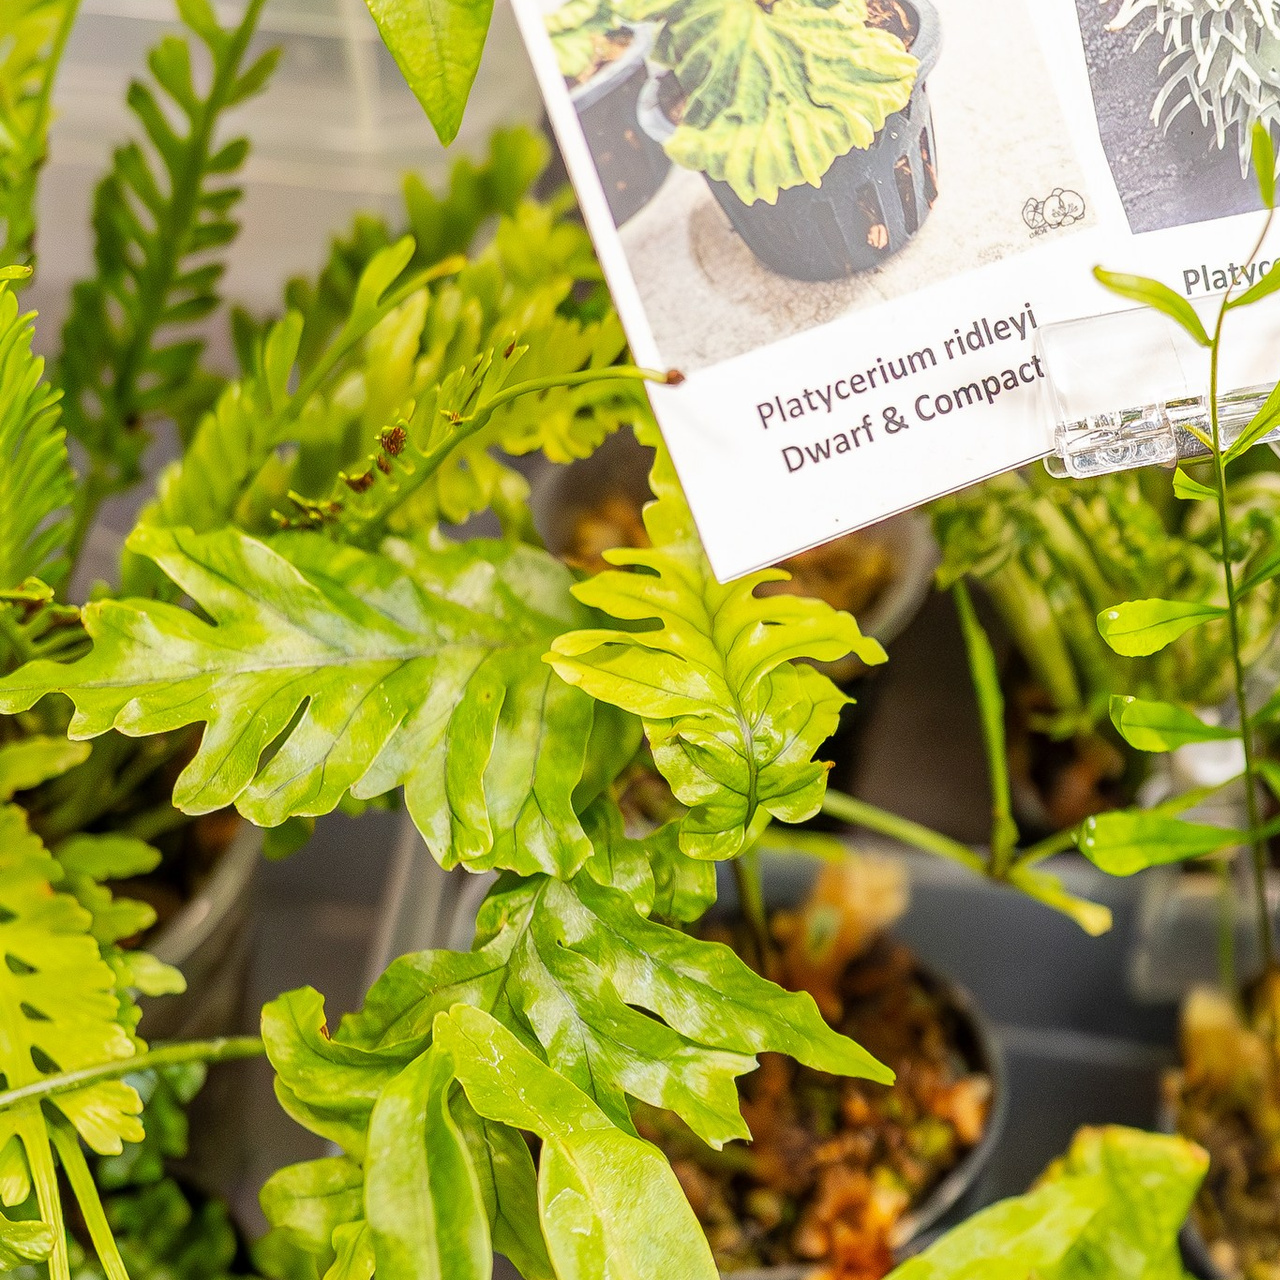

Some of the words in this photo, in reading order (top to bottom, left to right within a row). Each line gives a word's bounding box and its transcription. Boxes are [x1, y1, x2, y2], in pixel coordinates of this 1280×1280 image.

[756, 347, 938, 429] Platycerium
[944, 302, 1038, 360] ridleyi
[781, 414, 875, 474] Dwarf
[883, 406, 909, 434] &
[914, 355, 1045, 421] Compact
